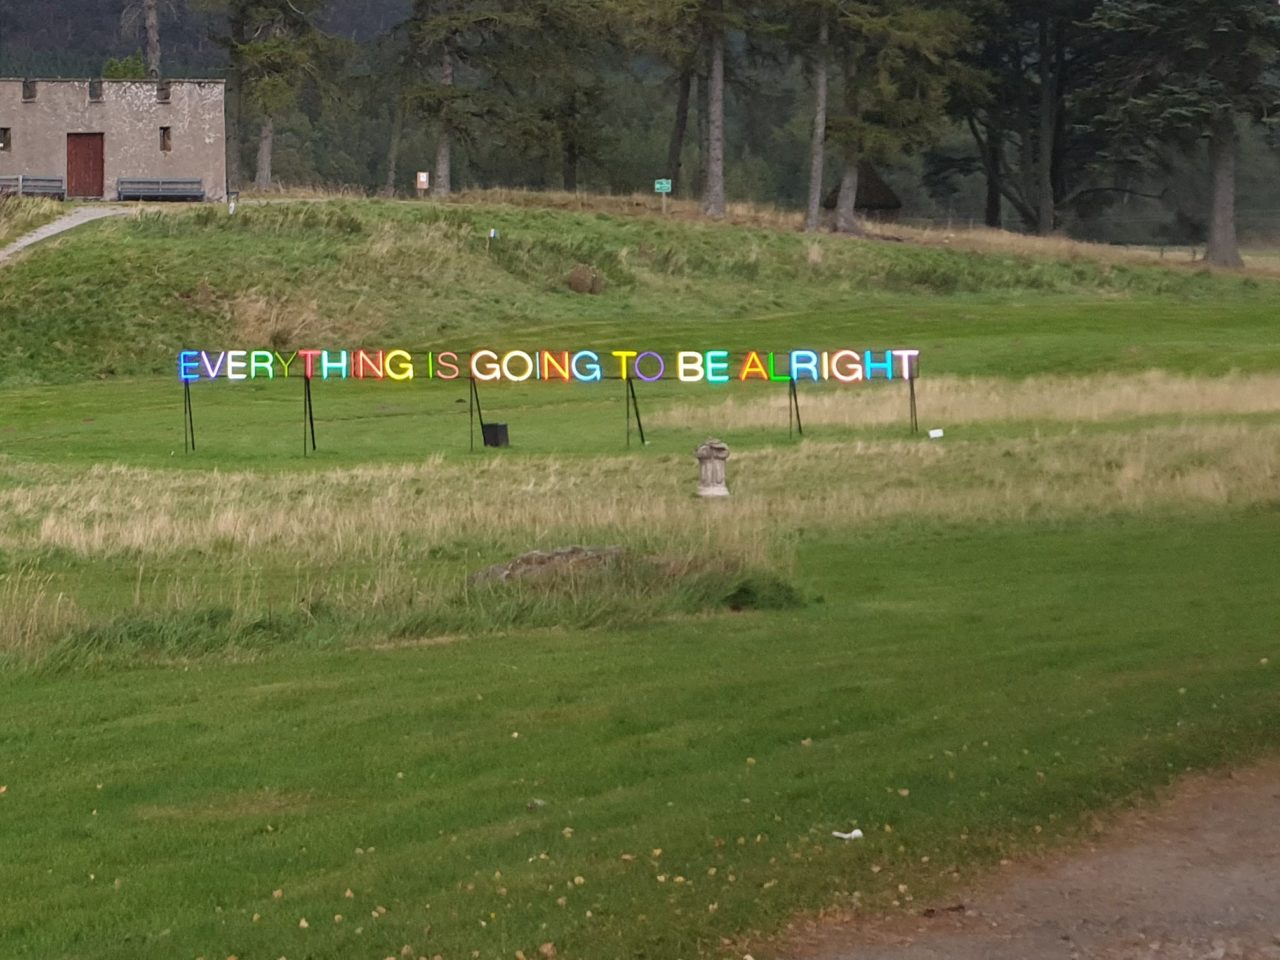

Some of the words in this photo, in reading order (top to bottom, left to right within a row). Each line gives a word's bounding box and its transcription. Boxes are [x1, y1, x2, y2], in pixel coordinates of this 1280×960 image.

[178, 349, 414, 381] EVERYTHING
[428, 350, 459, 380] IS
[470, 349, 603, 382] GOING
[612, 350, 666, 382] TO
[677, 350, 730, 383] BE
[739, 349, 920, 383] ALRIGHT
